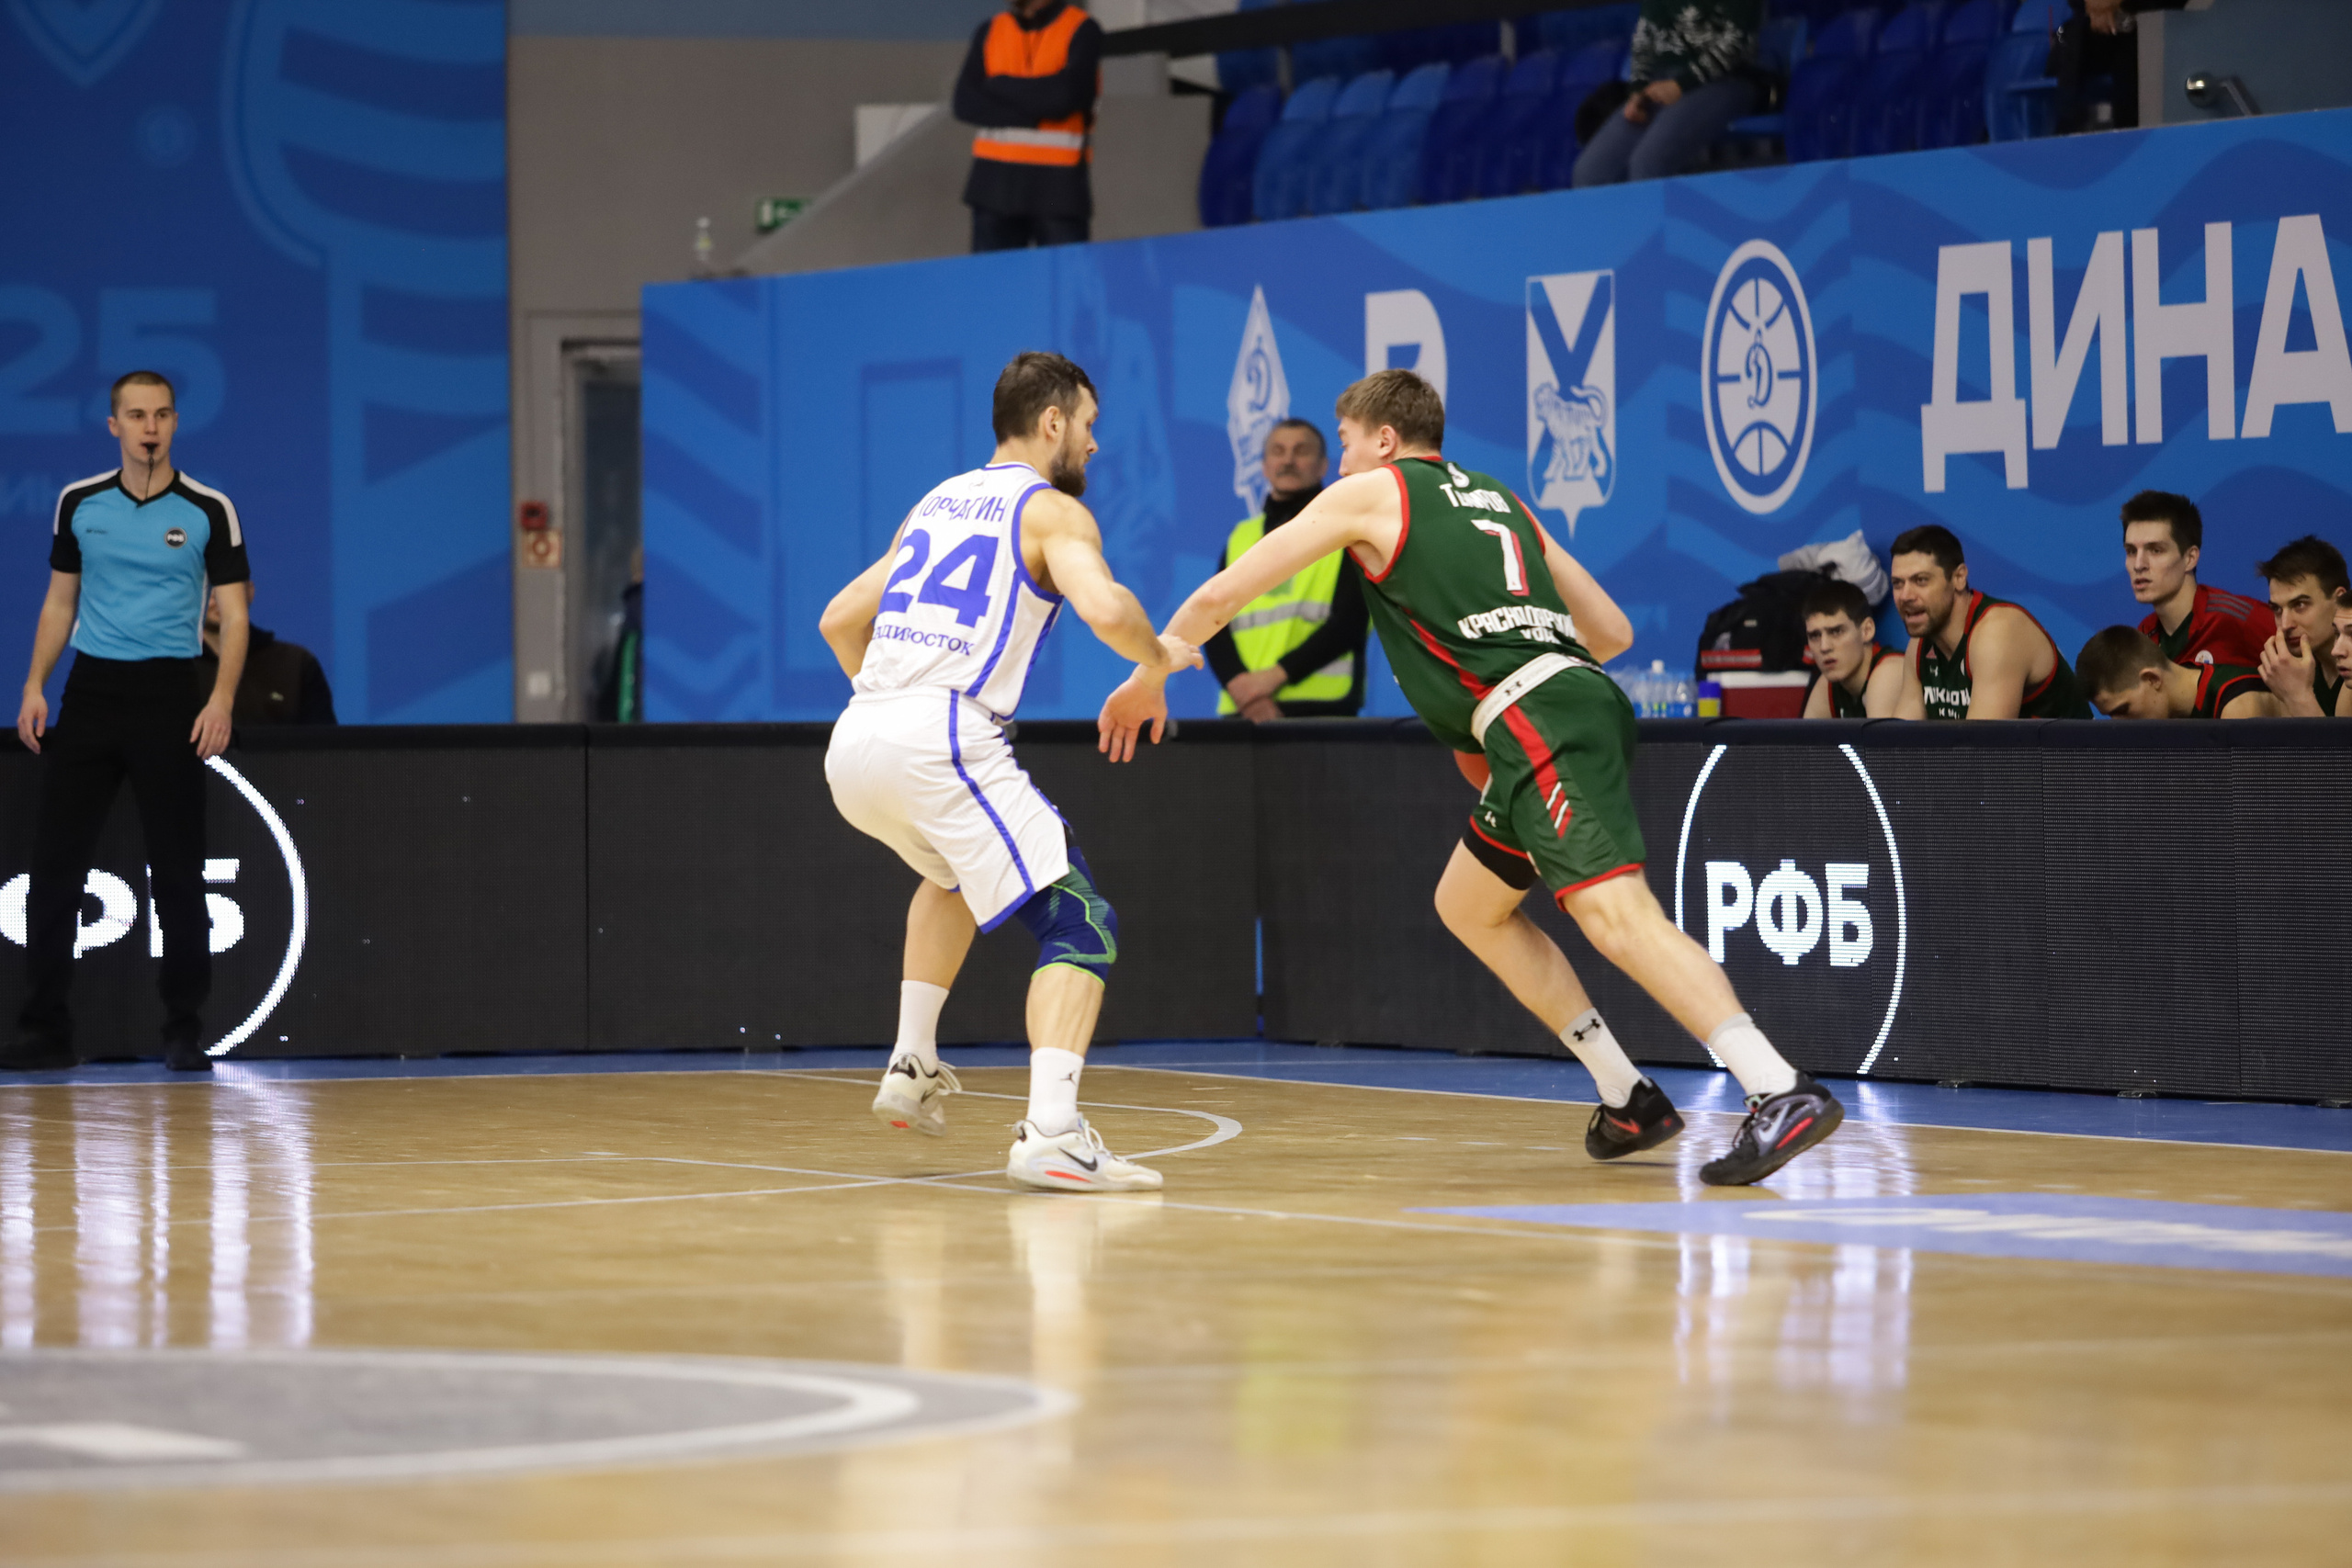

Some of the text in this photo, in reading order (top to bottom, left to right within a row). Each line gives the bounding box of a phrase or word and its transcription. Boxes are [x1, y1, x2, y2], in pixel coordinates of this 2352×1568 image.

[919, 496, 1010, 522] ОРЧАГИН
[877, 528, 999, 628] 24
[1471, 519, 1530, 596] 7
[872, 625, 974, 656] АДИВОСТОК
[1705, 859, 1873, 967] РФБ
